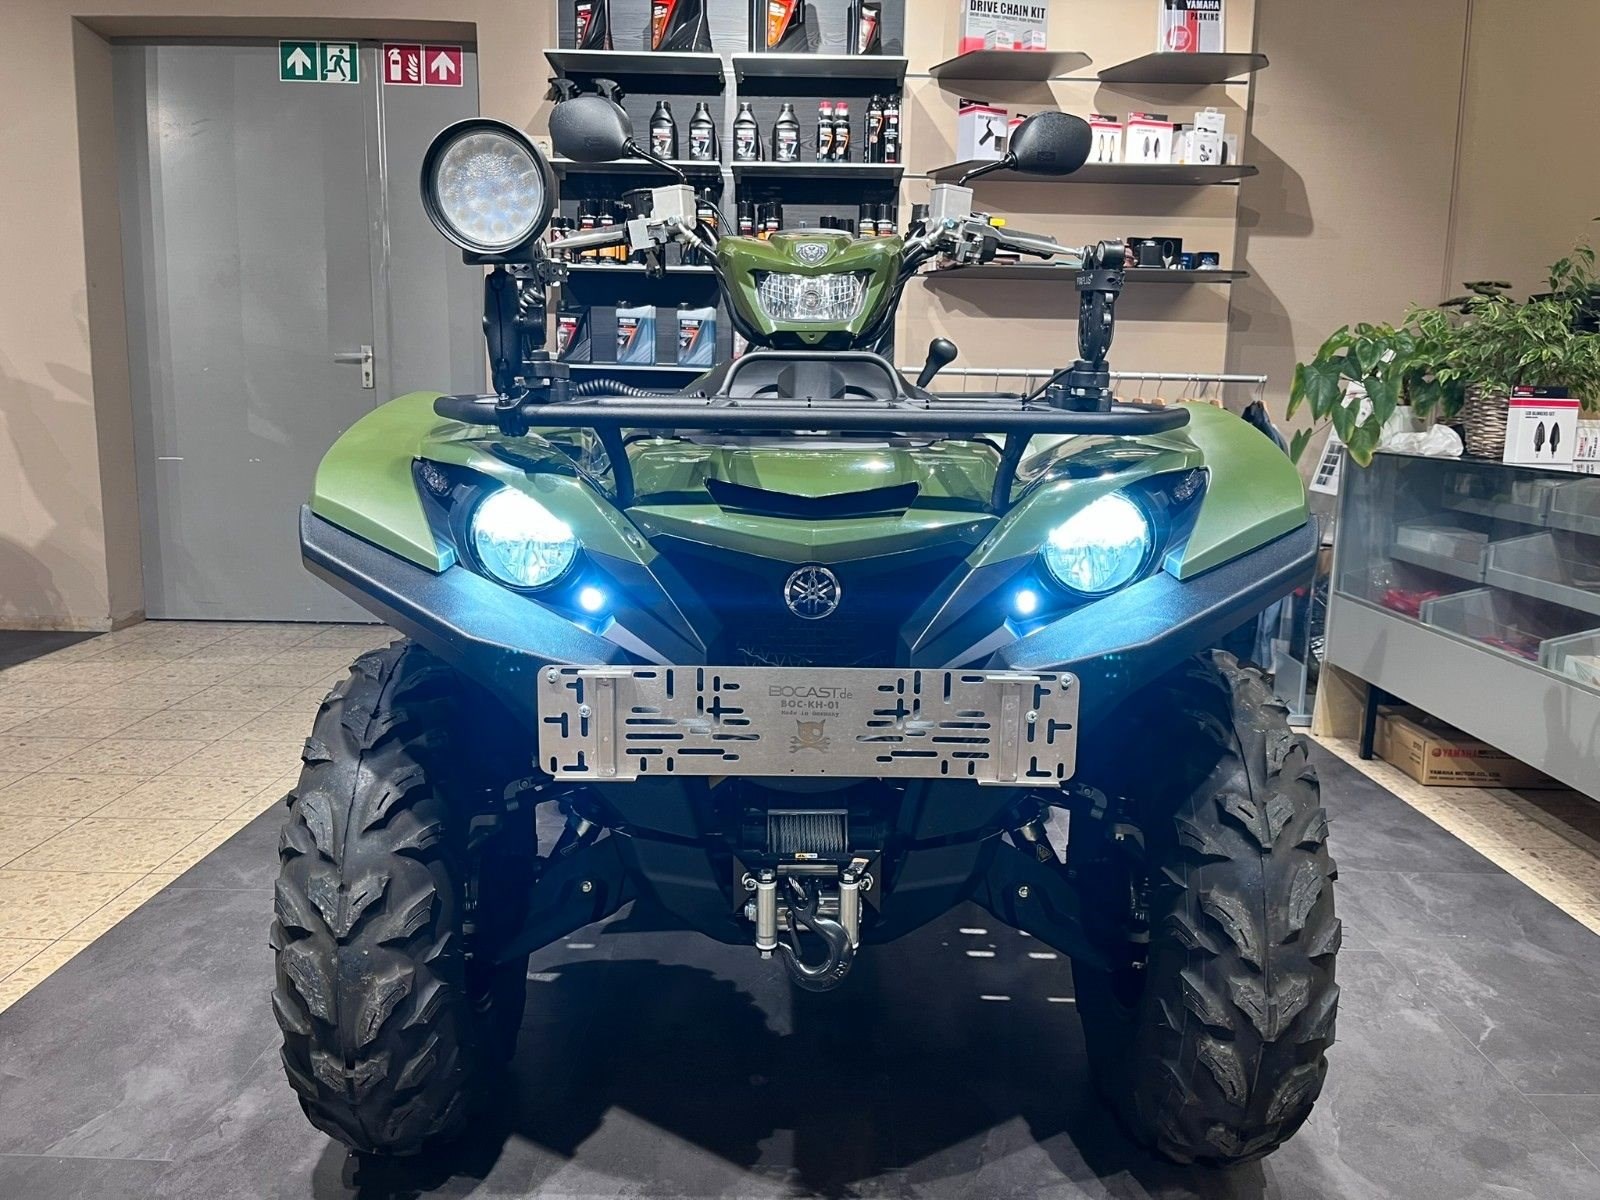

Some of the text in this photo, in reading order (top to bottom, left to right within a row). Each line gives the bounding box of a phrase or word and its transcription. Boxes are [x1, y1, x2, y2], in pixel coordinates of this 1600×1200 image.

[970, 0, 1046, 19] DRIVE CHAIN KIT
[1186, 0, 1220, 10] YAMAHA
[1190, 12, 1219, 21] PARKING
[768, 685, 854, 700] BOCAST.de
[781, 700, 840, 710] BOC-KH-01
